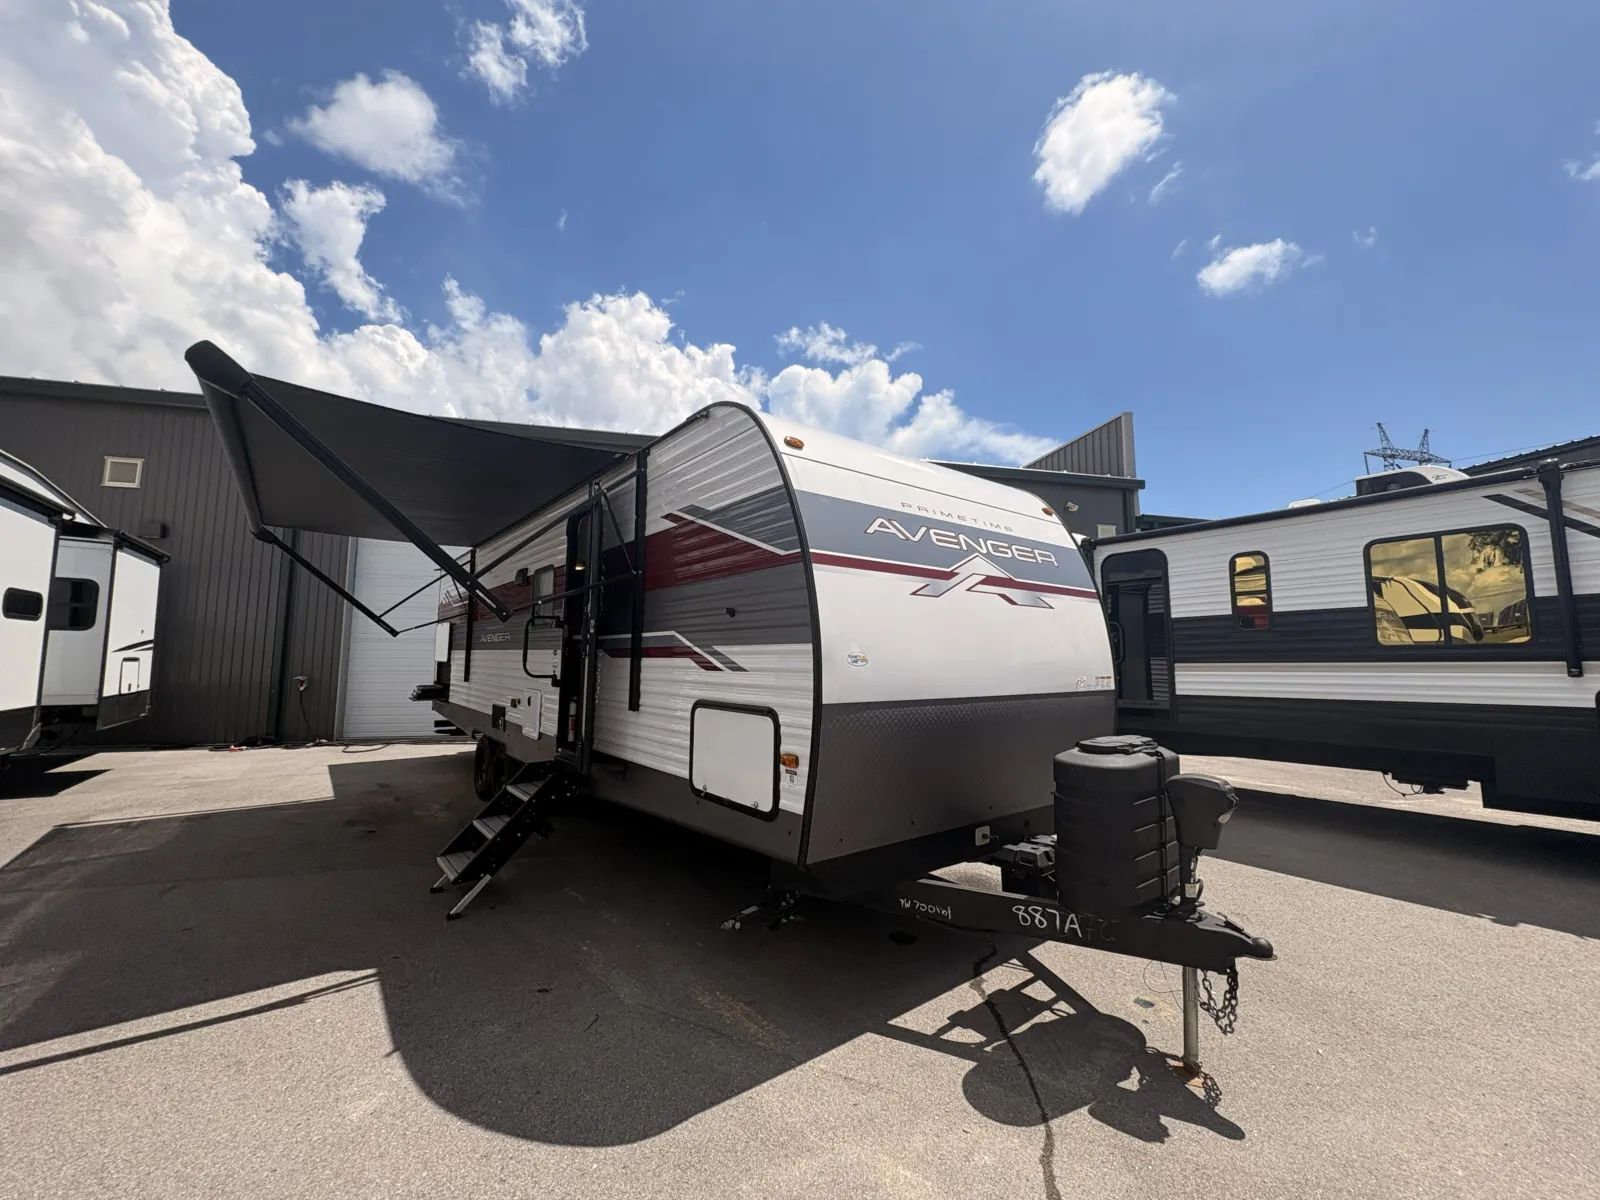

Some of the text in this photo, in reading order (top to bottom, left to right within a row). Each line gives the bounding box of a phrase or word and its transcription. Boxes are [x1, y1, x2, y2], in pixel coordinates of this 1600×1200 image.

[901, 502, 1014, 532] PRIMETIME
[864, 517, 1059, 567] AVENGER
[1012, 905, 1082, 938] 887A
